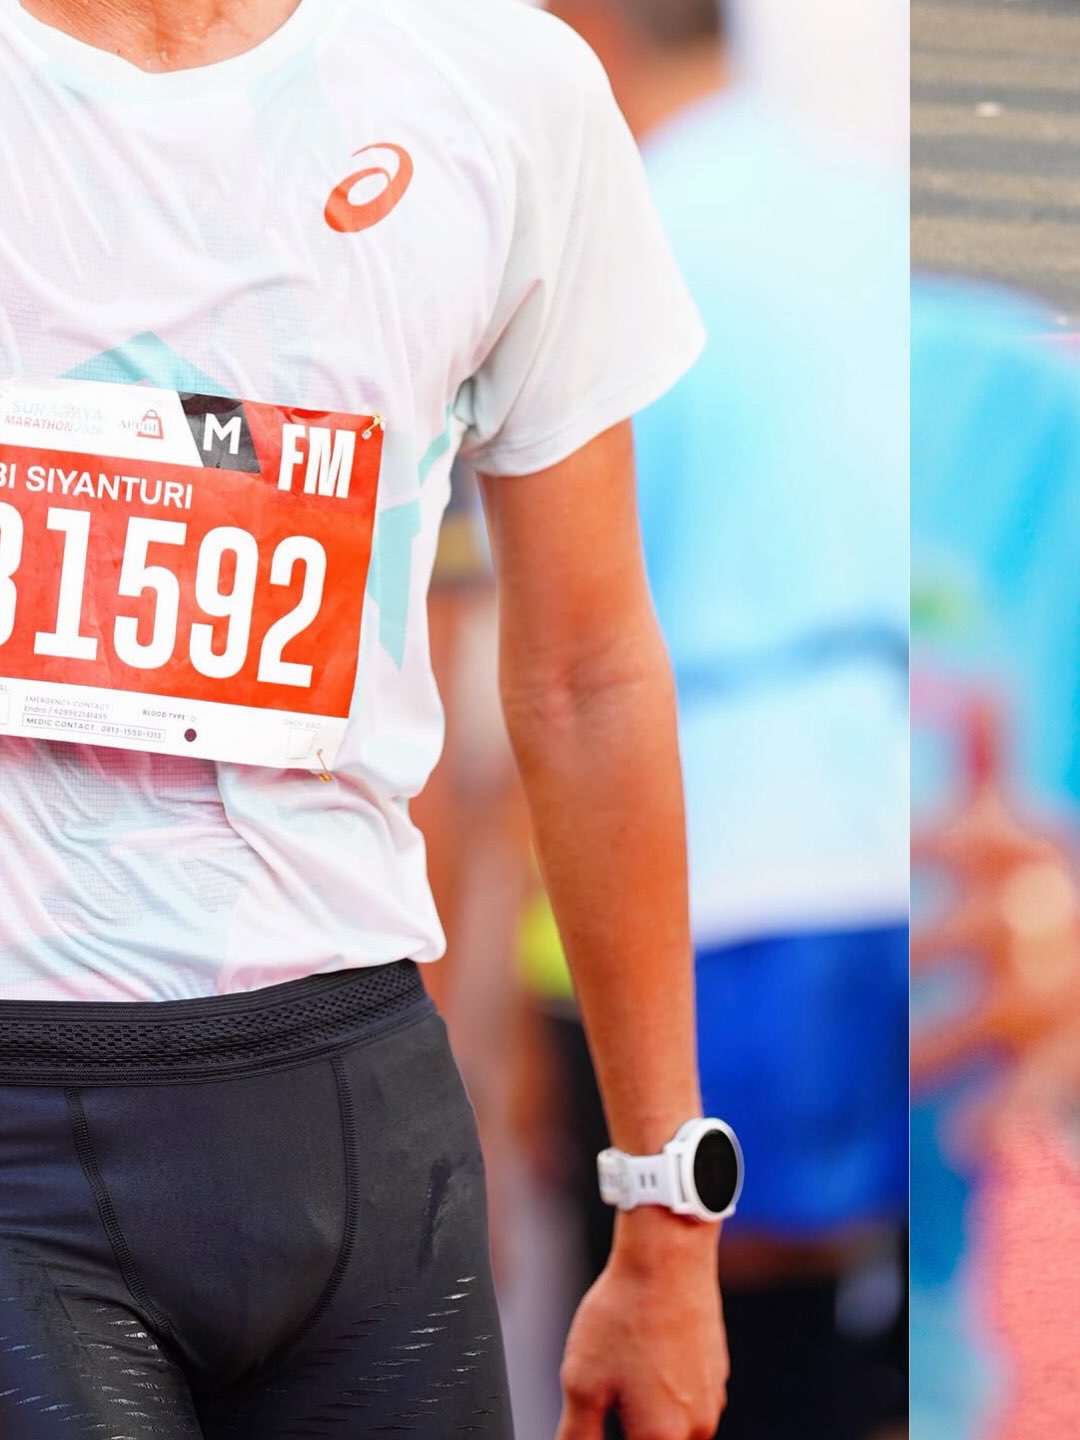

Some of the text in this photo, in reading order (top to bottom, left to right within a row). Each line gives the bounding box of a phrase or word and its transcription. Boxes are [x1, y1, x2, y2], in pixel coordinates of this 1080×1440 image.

[4, 415, 73, 433] MARATHON
[203, 412, 241, 455] M
[277, 423, 356, 500] FM
[25, 466, 193, 510] SIYANTURI
[26, 717, 53, 728] MEDIC
[54, 720, 95, 733] CONTACT
[142, 708, 167, 718] BLOOD
[168, 712, 185, 721] TYPE
